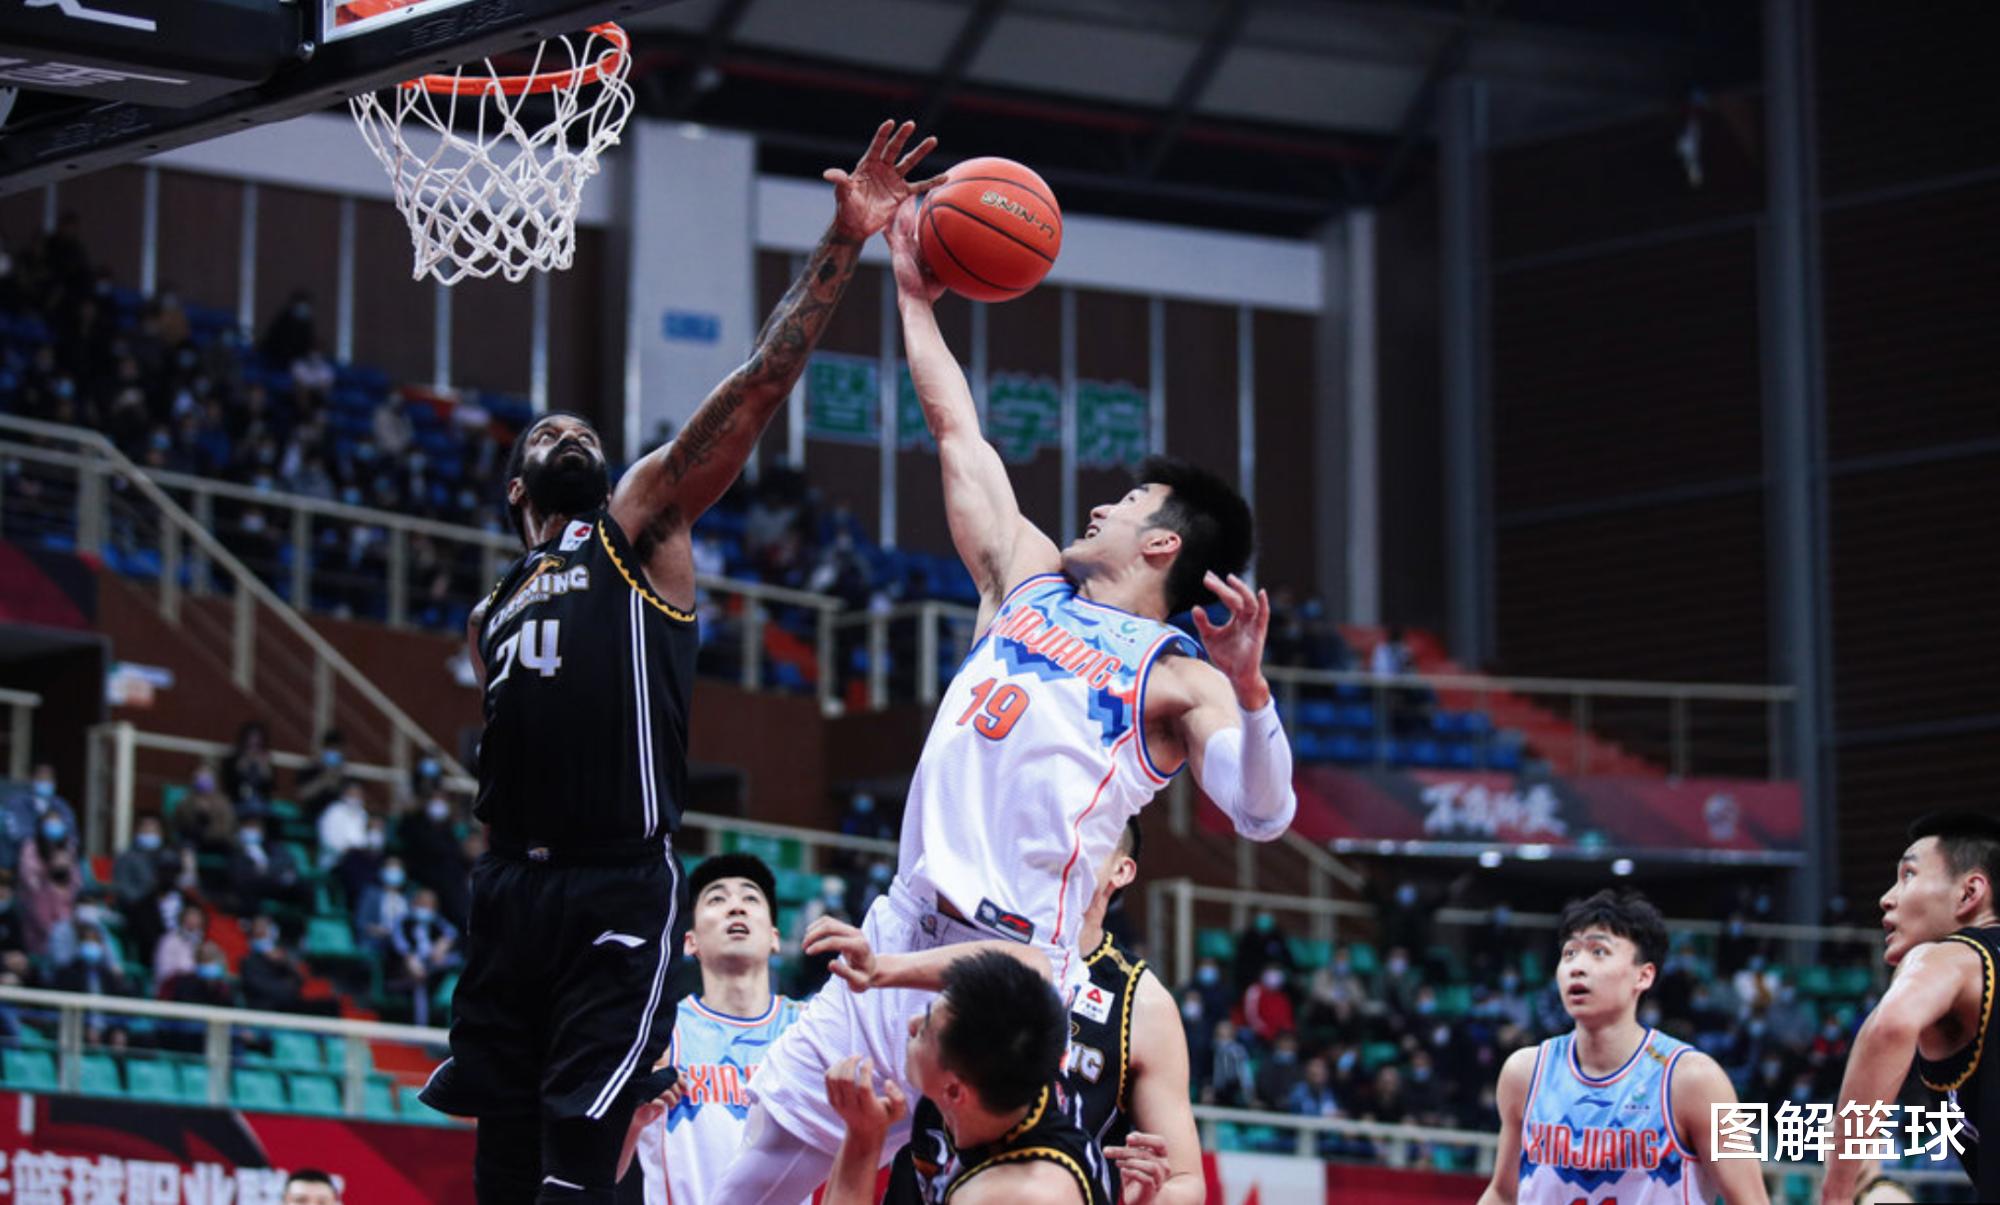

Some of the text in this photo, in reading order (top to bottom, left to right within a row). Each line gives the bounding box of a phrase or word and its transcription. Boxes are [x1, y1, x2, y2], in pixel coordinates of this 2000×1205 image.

[980, 190, 1056, 241] LI-NING
[487, 618, 562, 691] 24
[956, 677, 1030, 741] 19
[1527, 1123, 1660, 1170] XINJIANG
